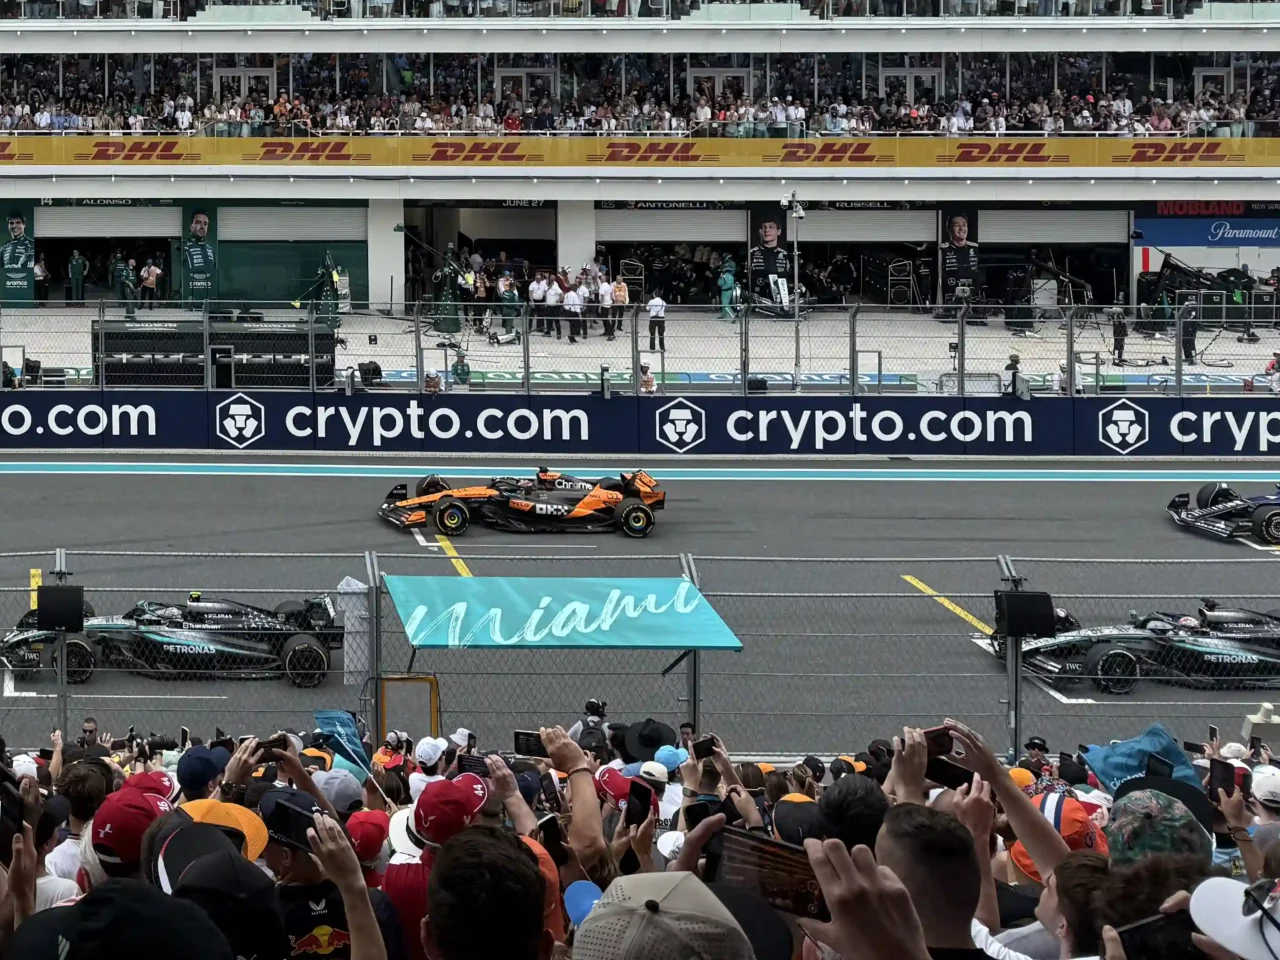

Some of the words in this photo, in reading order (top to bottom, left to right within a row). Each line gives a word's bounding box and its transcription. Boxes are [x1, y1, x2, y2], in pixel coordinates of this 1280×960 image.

[91, 141, 183, 161] DHL
[260, 141, 353, 161] DHL
[430, 142, 526, 162] DHL
[605, 142, 701, 162] DHL
[781, 142, 876, 163] DHL
[954, 142, 1051, 163] DHL
[1130, 142, 1227, 163] DHL
[1156, 201, 1245, 215] MOBLAND
[285, 400, 590, 447] crypto.com
[726, 403, 1033, 451] crypto.com
[535, 503, 569, 516] OKX
[403, 580, 702, 649] Miami
[24, 652, 40, 660] IWC
[163, 644, 217, 654] PETRONAS
[1203, 654, 1260, 664] PETRONAS
[1066, 663, 1082, 671] IWC
[472, 784, 485, 797] 44
[156, 800, 170, 812] 16
